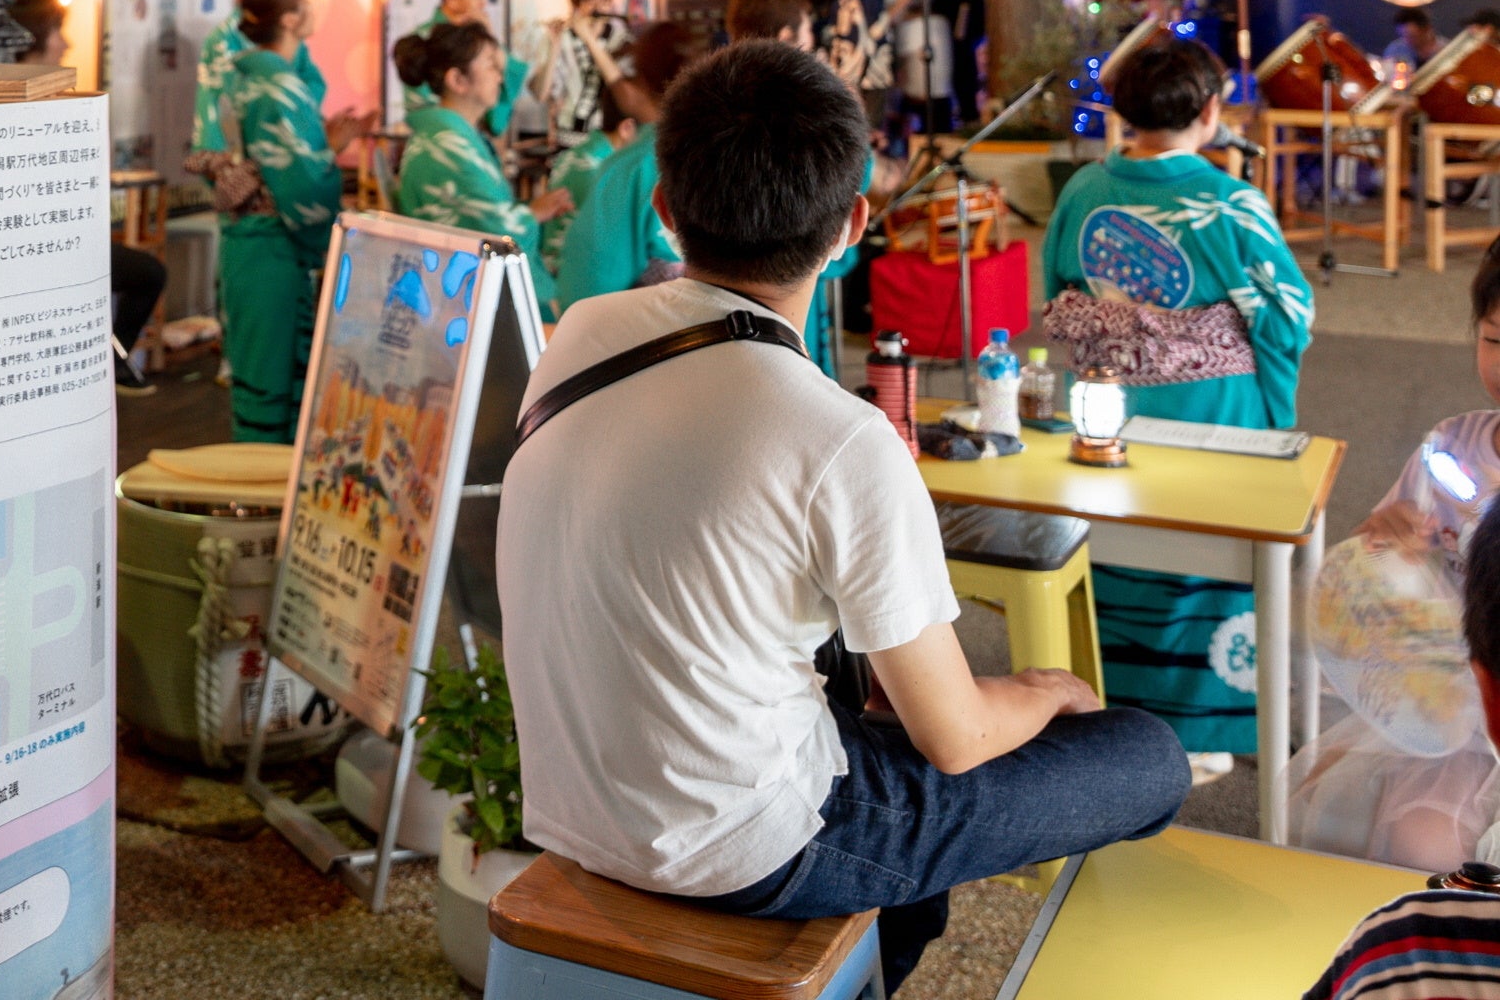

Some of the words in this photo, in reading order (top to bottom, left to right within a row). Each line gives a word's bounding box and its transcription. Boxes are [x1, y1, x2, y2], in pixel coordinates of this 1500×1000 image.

[37, 682, 76, 705] 万代口バス
[38, 698, 76, 720] ターミナル
